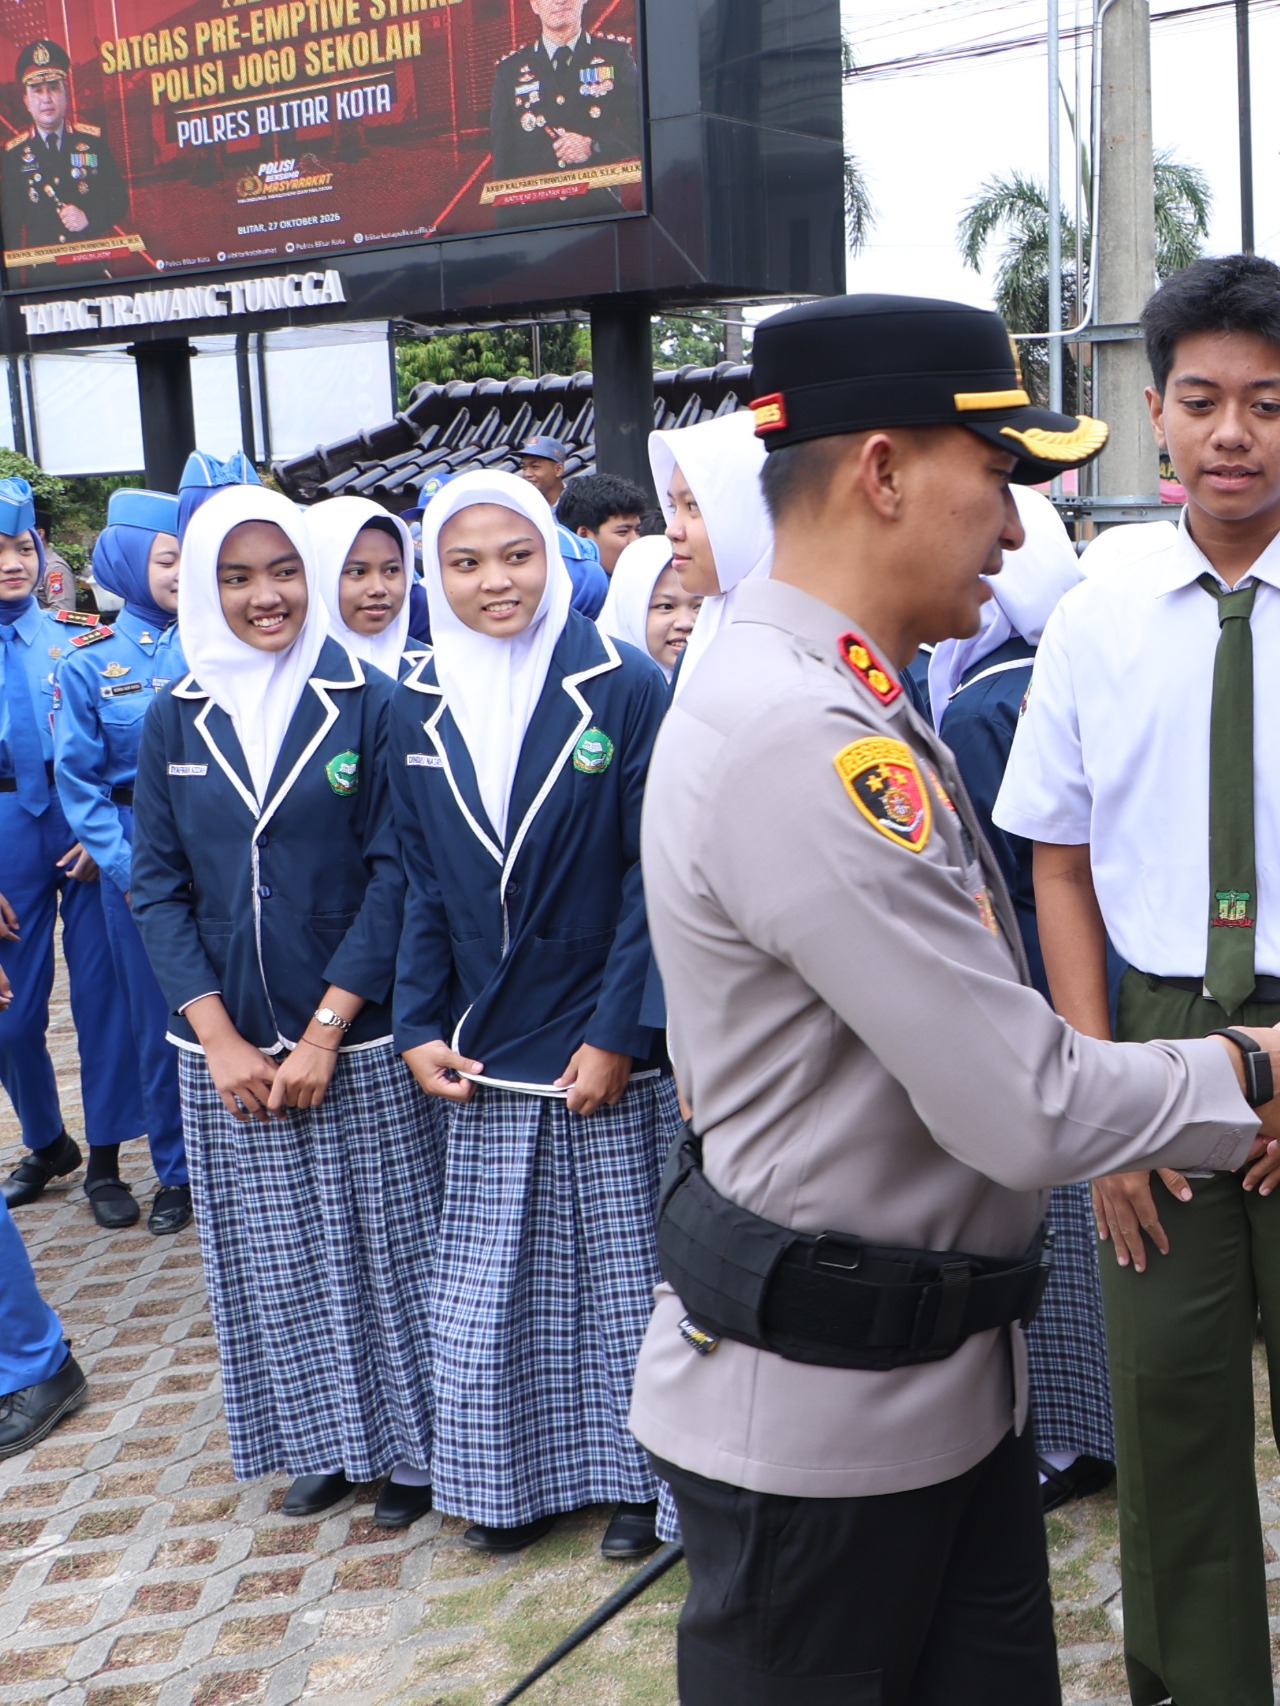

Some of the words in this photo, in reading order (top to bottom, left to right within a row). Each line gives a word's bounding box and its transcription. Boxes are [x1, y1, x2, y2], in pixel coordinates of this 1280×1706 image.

[100, 26, 189, 75] SATGAS
[194, 0, 361, 58] PRE-EMPTIVE
[151, 60, 226, 106] POLISI
[231, 45, 296, 91] JOGO
[304, 20, 421, 77] SEKOLAH
[176, 110, 251, 149] POLRES
[256, 94, 329, 135] BLITAR
[336, 83, 392, 121] KOTA
[258, 158, 296, 177] POLISI
[263, 173, 334, 195] MASYARAKAT
[268, 221, 278, 231] 27
[279, 216, 318, 229] OKTOBER
[20, 298, 99, 335] TATAG
[95, 284, 228, 328] TRAWANG
[225, 269, 347, 314] TUNGGA
